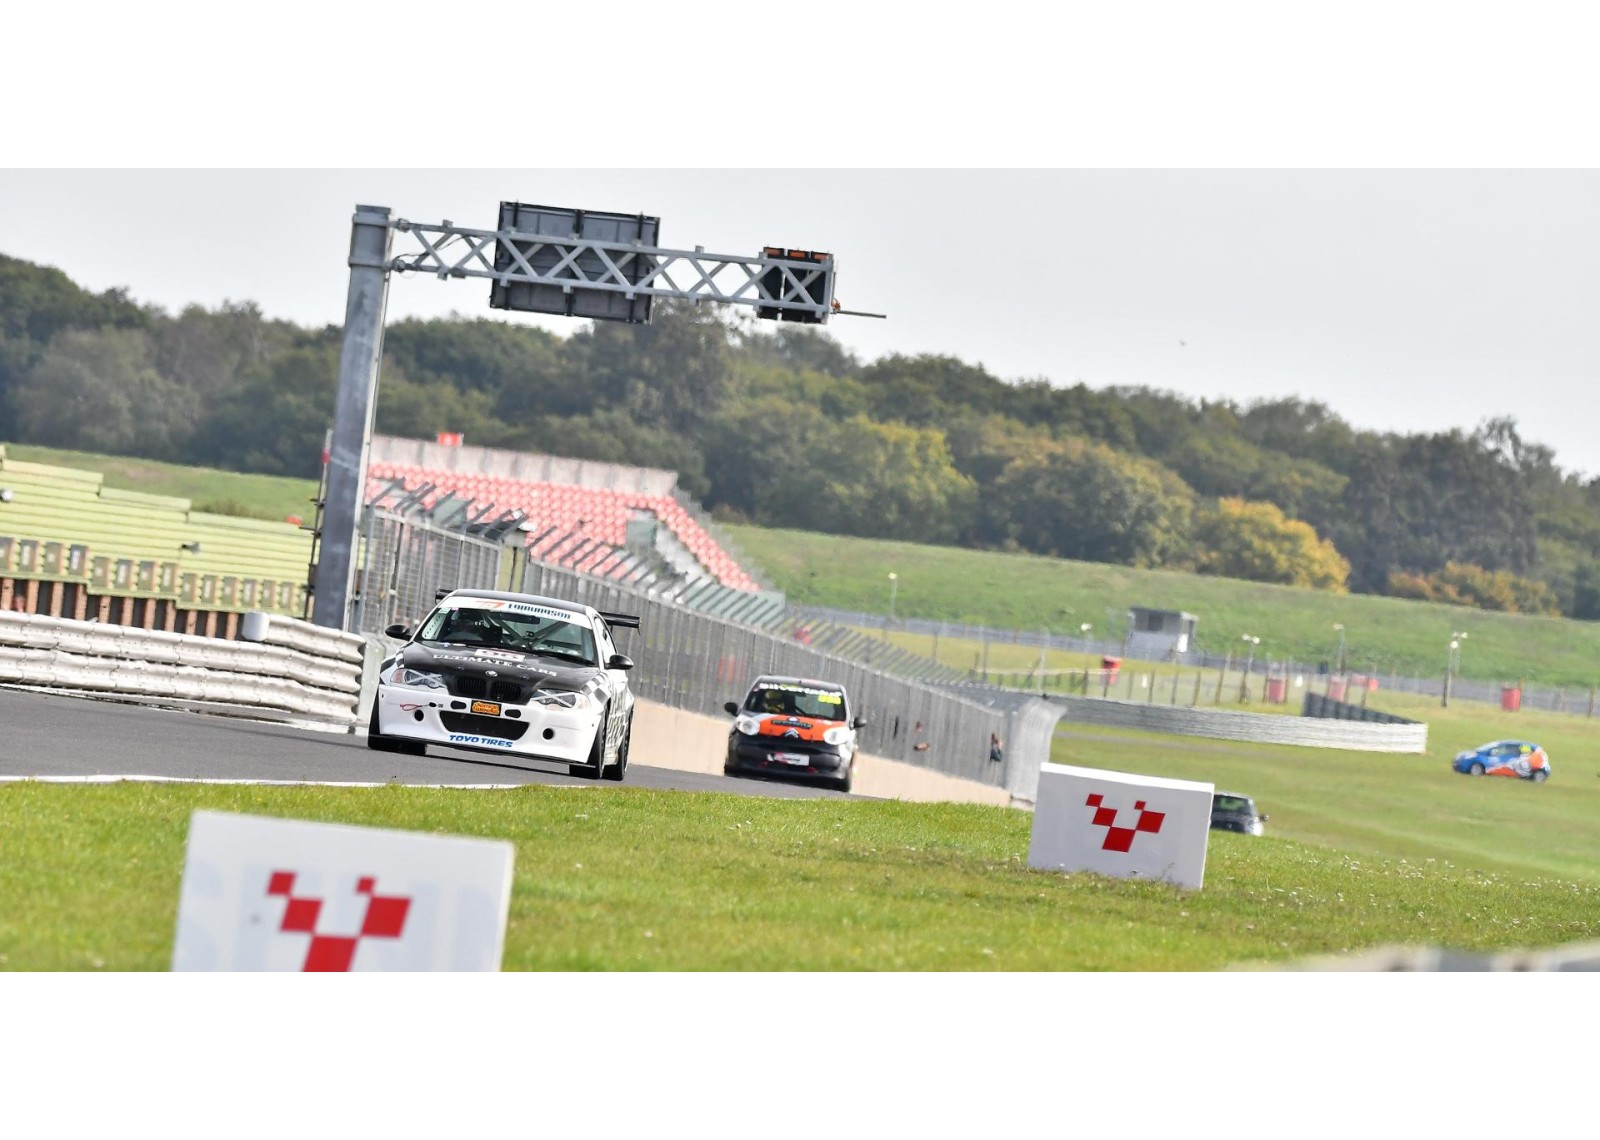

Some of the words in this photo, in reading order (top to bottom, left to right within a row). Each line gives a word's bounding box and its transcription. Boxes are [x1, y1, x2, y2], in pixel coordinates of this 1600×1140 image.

[433, 653, 513, 667] ULTIMATE
[449, 735, 480, 743] TOYO
[481, 738, 513, 748] TIRES
